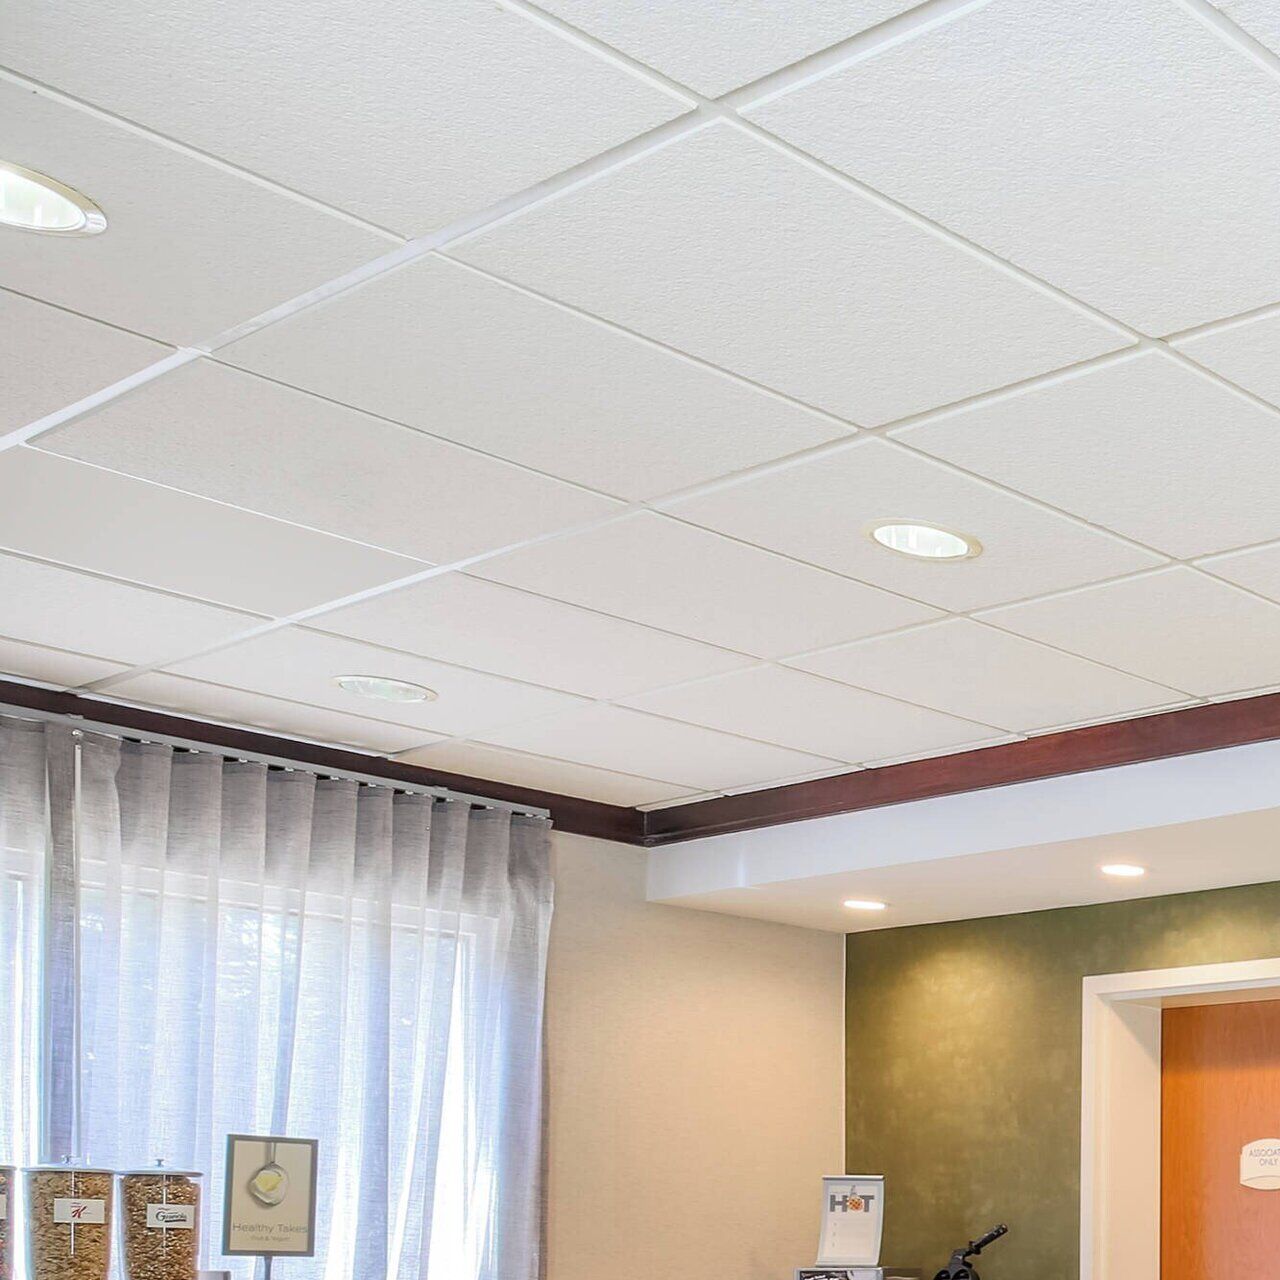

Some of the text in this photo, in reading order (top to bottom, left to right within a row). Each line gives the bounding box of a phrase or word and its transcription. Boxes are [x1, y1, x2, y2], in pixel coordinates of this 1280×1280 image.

[1258, 1158, 1278, 1167] ONLY
[232, 1223, 308, 1234] Healthy Takes
